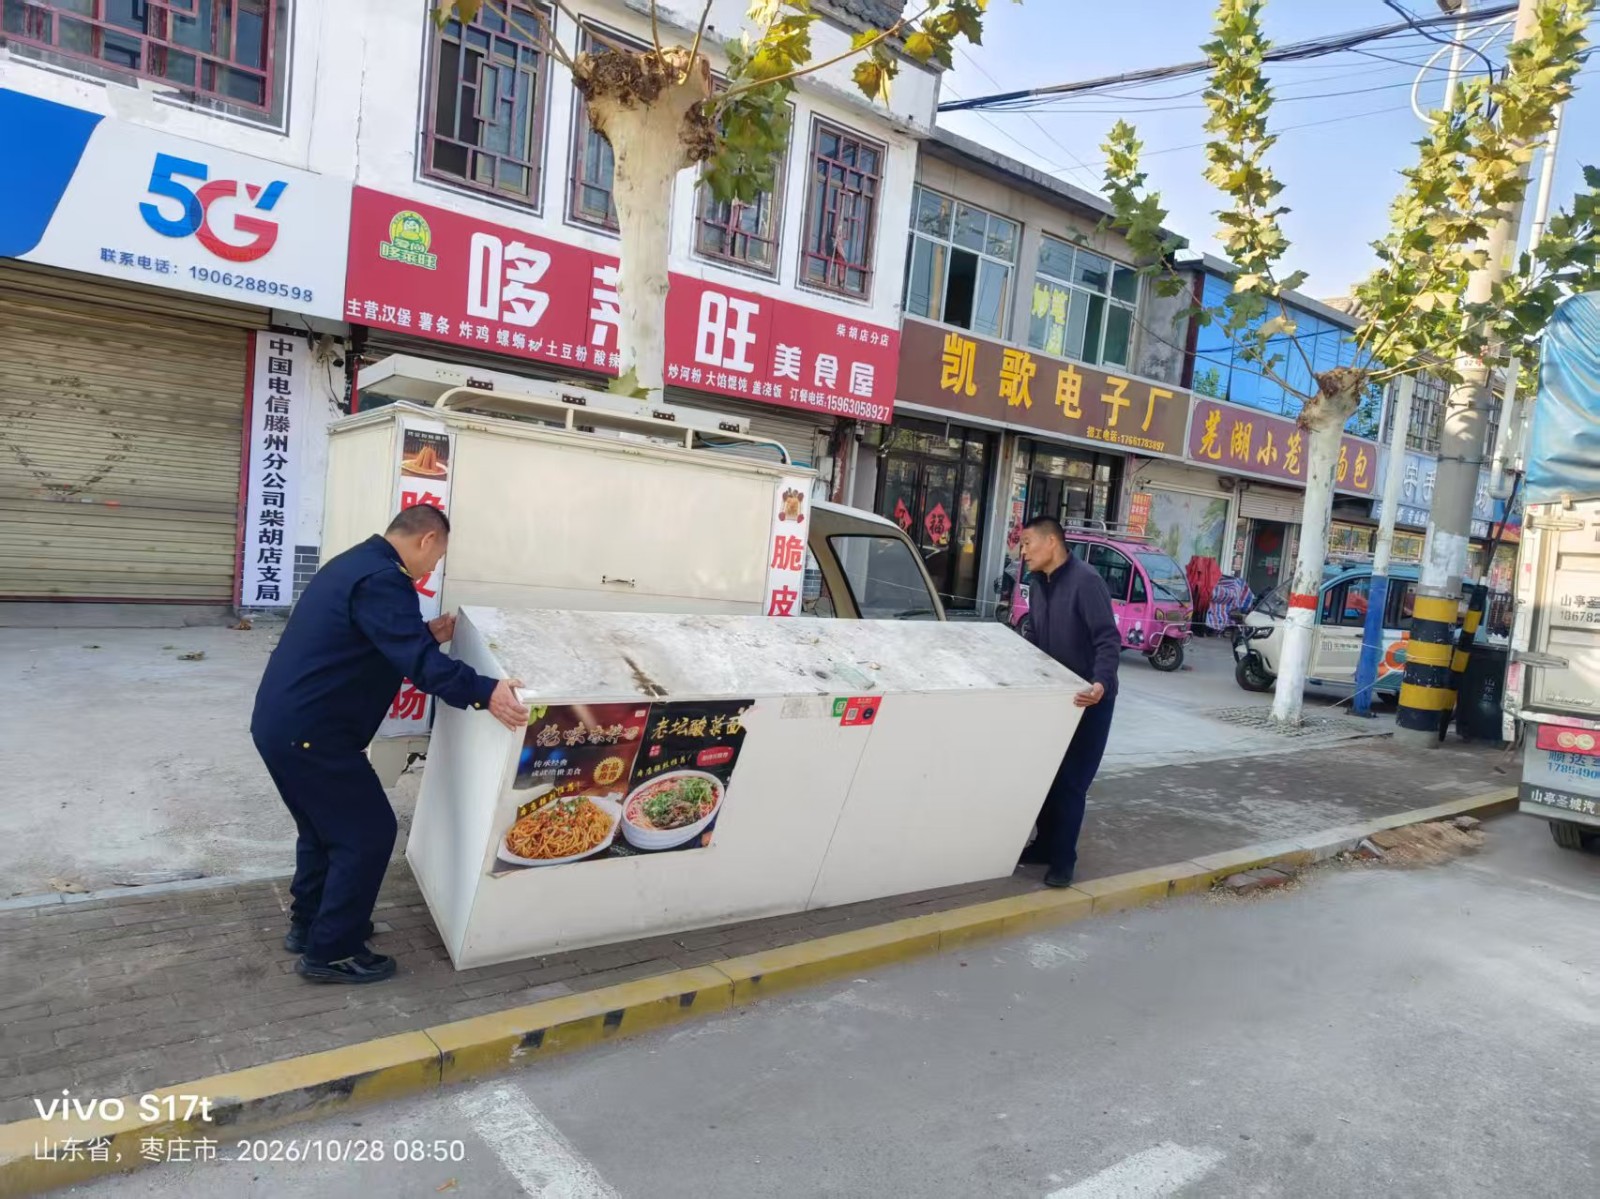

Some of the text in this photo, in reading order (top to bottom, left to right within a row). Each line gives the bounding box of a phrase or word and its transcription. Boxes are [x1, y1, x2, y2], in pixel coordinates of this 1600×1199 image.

[138, 152, 279, 262] 5G
[418, 311, 450, 335] 薯条
[459, 321, 489, 343] 炸鸡
[546, 340, 588, 363] 土豆粉
[668, 363, 702, 384] 炒河粉
[705, 370, 748, 393] 大馅馄饨
[751, 380, 783, 399] 盖浇饭
[773, 343, 876, 398] 美食屋
[836, 323, 890, 347] 柴胡店分店
[940, 332, 1174, 432] 凯歌电子厂
[255, 338, 294, 602] 中国电信滕州分公司柴胡店支局
[930, 513, 945, 536] 福
[768, 535, 805, 616] 脆皮
